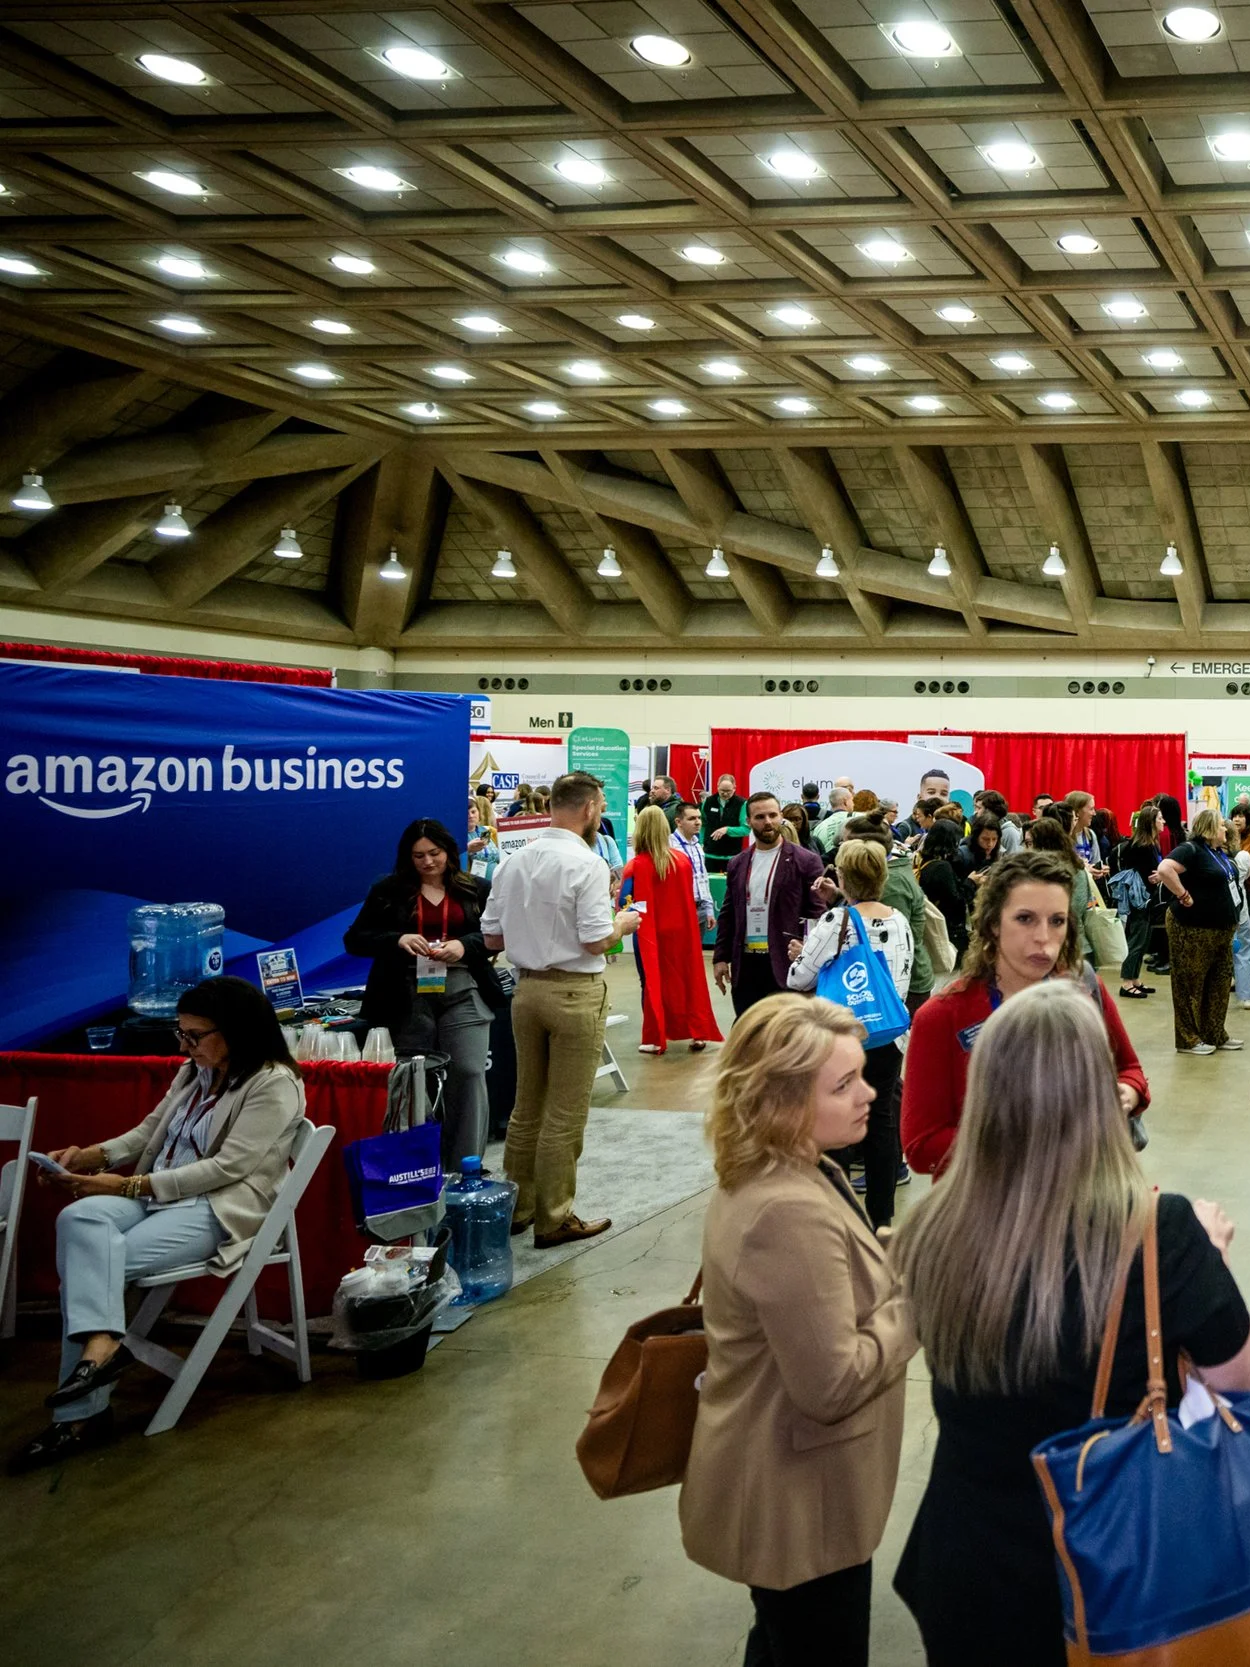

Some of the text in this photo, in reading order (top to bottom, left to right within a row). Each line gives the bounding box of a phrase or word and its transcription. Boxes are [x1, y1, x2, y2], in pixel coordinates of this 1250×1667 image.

[529, 716, 555, 728] Men
[5, 744, 404, 794] amazon business
[501, 838, 527, 850] amazon
[389, 1168, 425, 1183] AUSTILL'S
